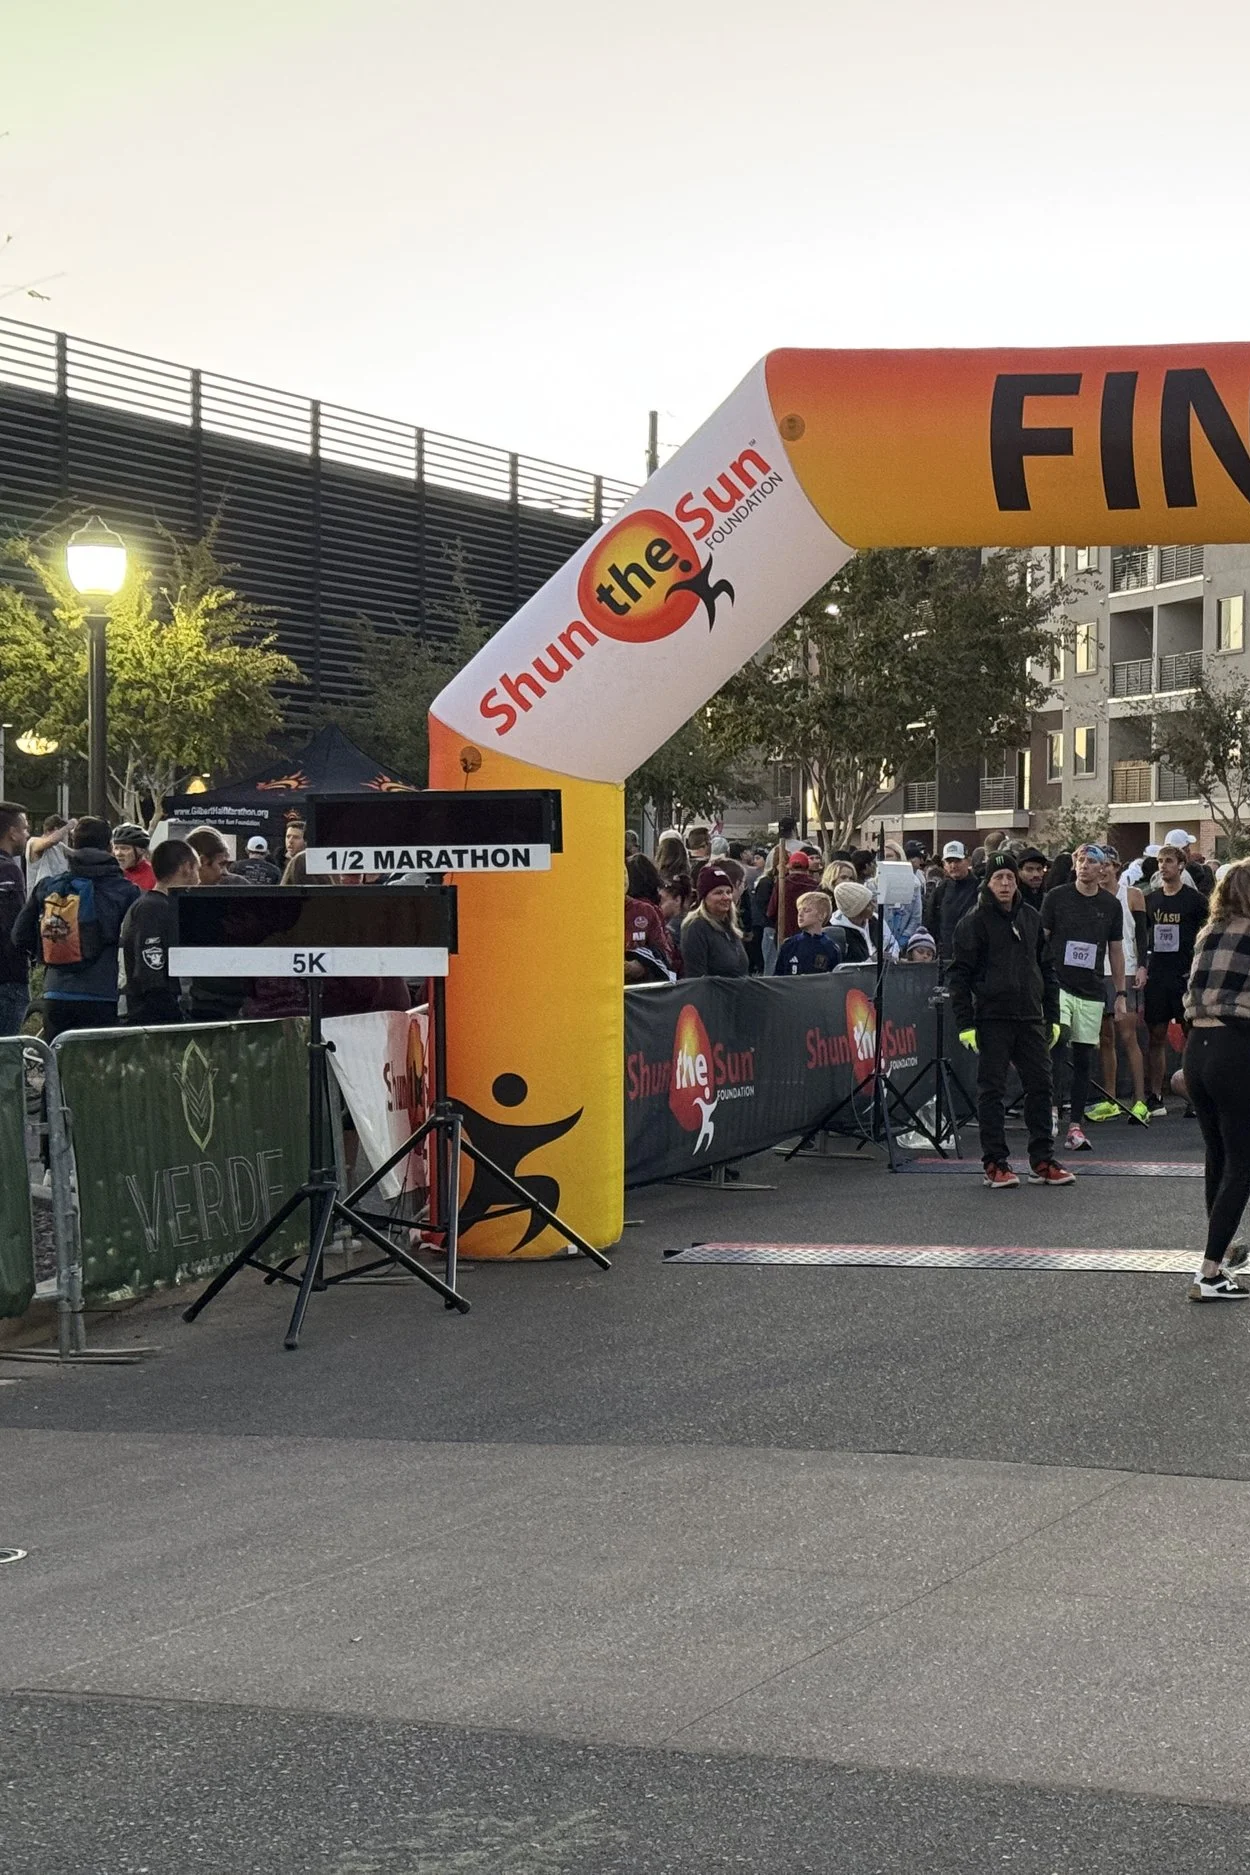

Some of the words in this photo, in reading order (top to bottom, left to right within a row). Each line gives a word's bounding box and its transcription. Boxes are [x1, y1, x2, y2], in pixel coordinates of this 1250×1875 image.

[704, 471, 783, 551] FOUNDATION
[479, 620, 599, 736] Shun
[596, 538, 678, 616] the
[675, 448, 771, 541] Sun
[326, 850, 364, 870] 1/2
[374, 848, 531, 869] MARATHON
[1163, 913, 1181, 923] ASU
[292, 952, 327, 974] 5K
[1072, 950, 1089, 961] 907
[806, 1027, 851, 1070] Shun
[853, 1021, 876, 1061] th
[627, 1053, 673, 1100] Shun
[676, 1044, 707, 1090] the
[713, 1042, 755, 1086] Sun
[890, 1056, 918, 1071] FOUNDATION
[717, 1085, 755, 1100] FOUNDATION
[125, 1148, 284, 1253] VERDE
